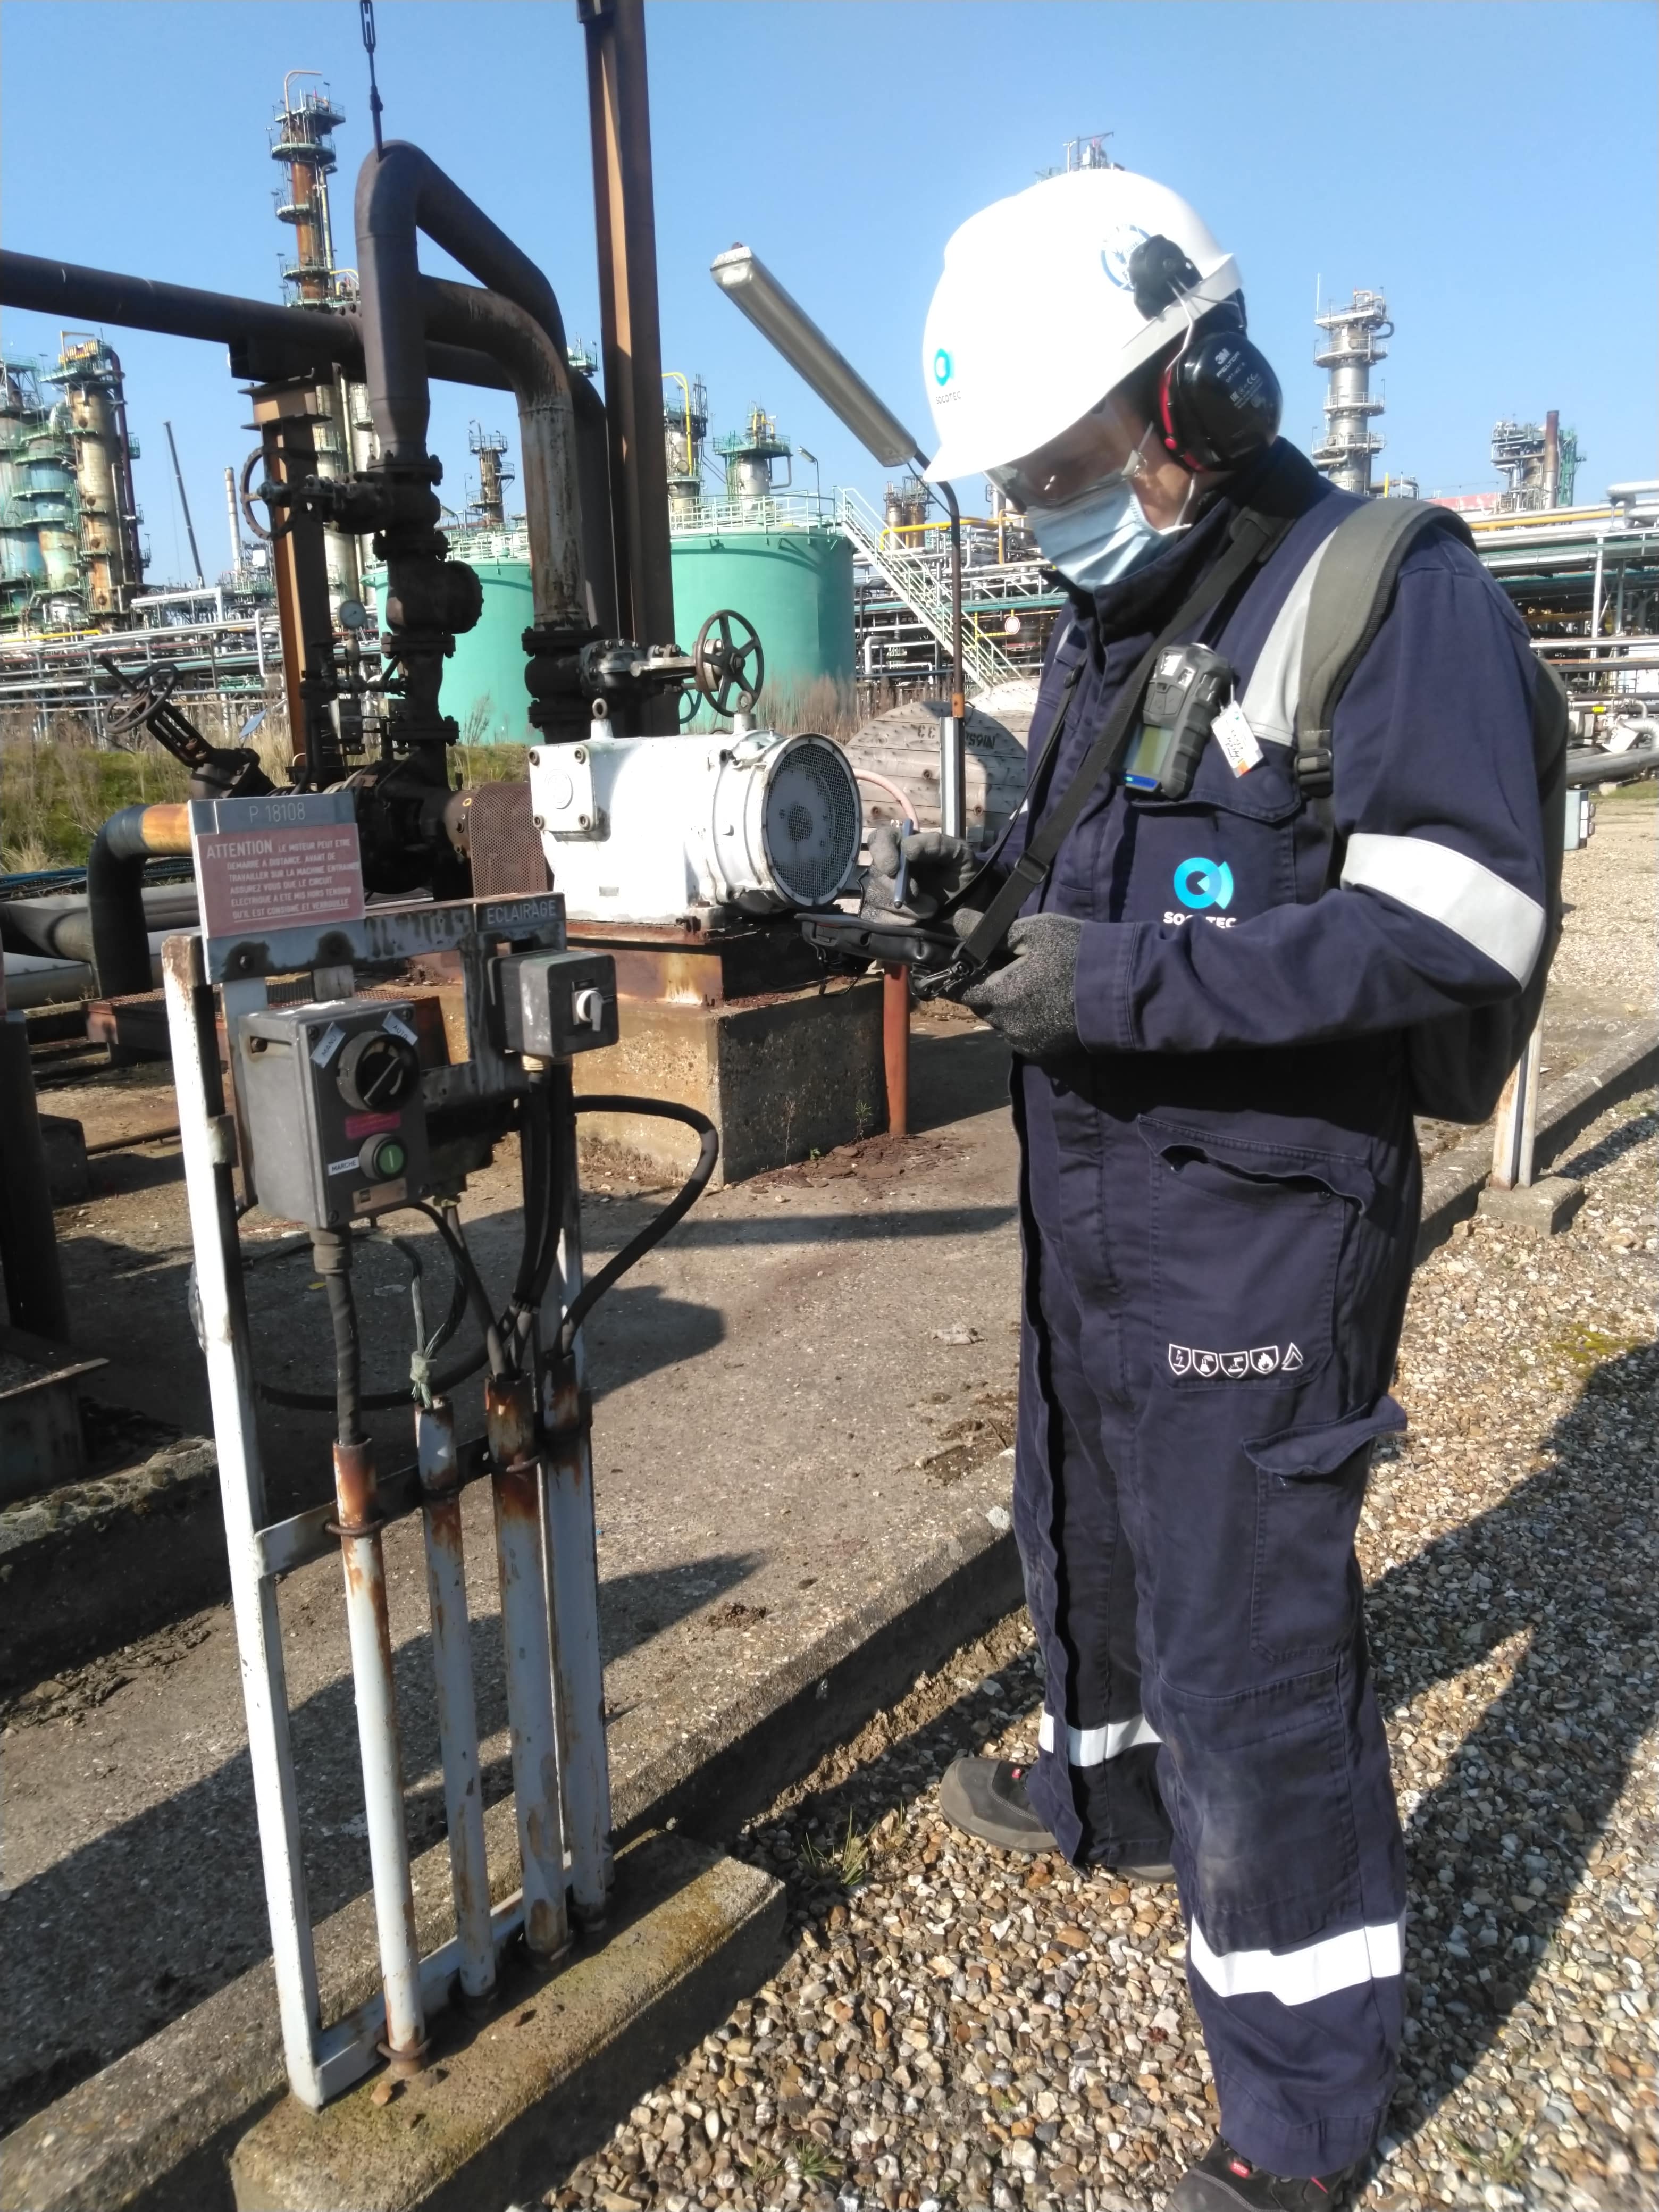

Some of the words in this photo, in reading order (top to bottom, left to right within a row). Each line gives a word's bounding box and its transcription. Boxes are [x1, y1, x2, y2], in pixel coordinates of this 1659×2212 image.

[1215, 348, 1230, 364] 3M
[936, 391, 961, 404] SOCOTEC
[249, 806, 258, 823] P
[265, 802, 305, 822] 18108
[207, 840, 273, 859] ATTENTION
[289, 842, 314, 851] MOTEUR
[227, 860, 259, 869] DEMARRE
[229, 872, 268, 882] TRAVAILLER
[297, 866, 324, 875] MACHINE
[230, 884, 260, 894] ASSUREZ
[309, 877, 331, 885] CIRCUIT
[231, 895, 271, 907] ELECTRIQUE
[325, 886, 351, 895] TENSION
[267, 904, 298, 915] CONSIGNE
[487, 900, 557, 925] ECLAIRAGE
[1163, 911, 1237, 929] SOTEC
[321, 1034, 337, 1057] MANU
[332, 1160, 357, 1172] MARCHE
